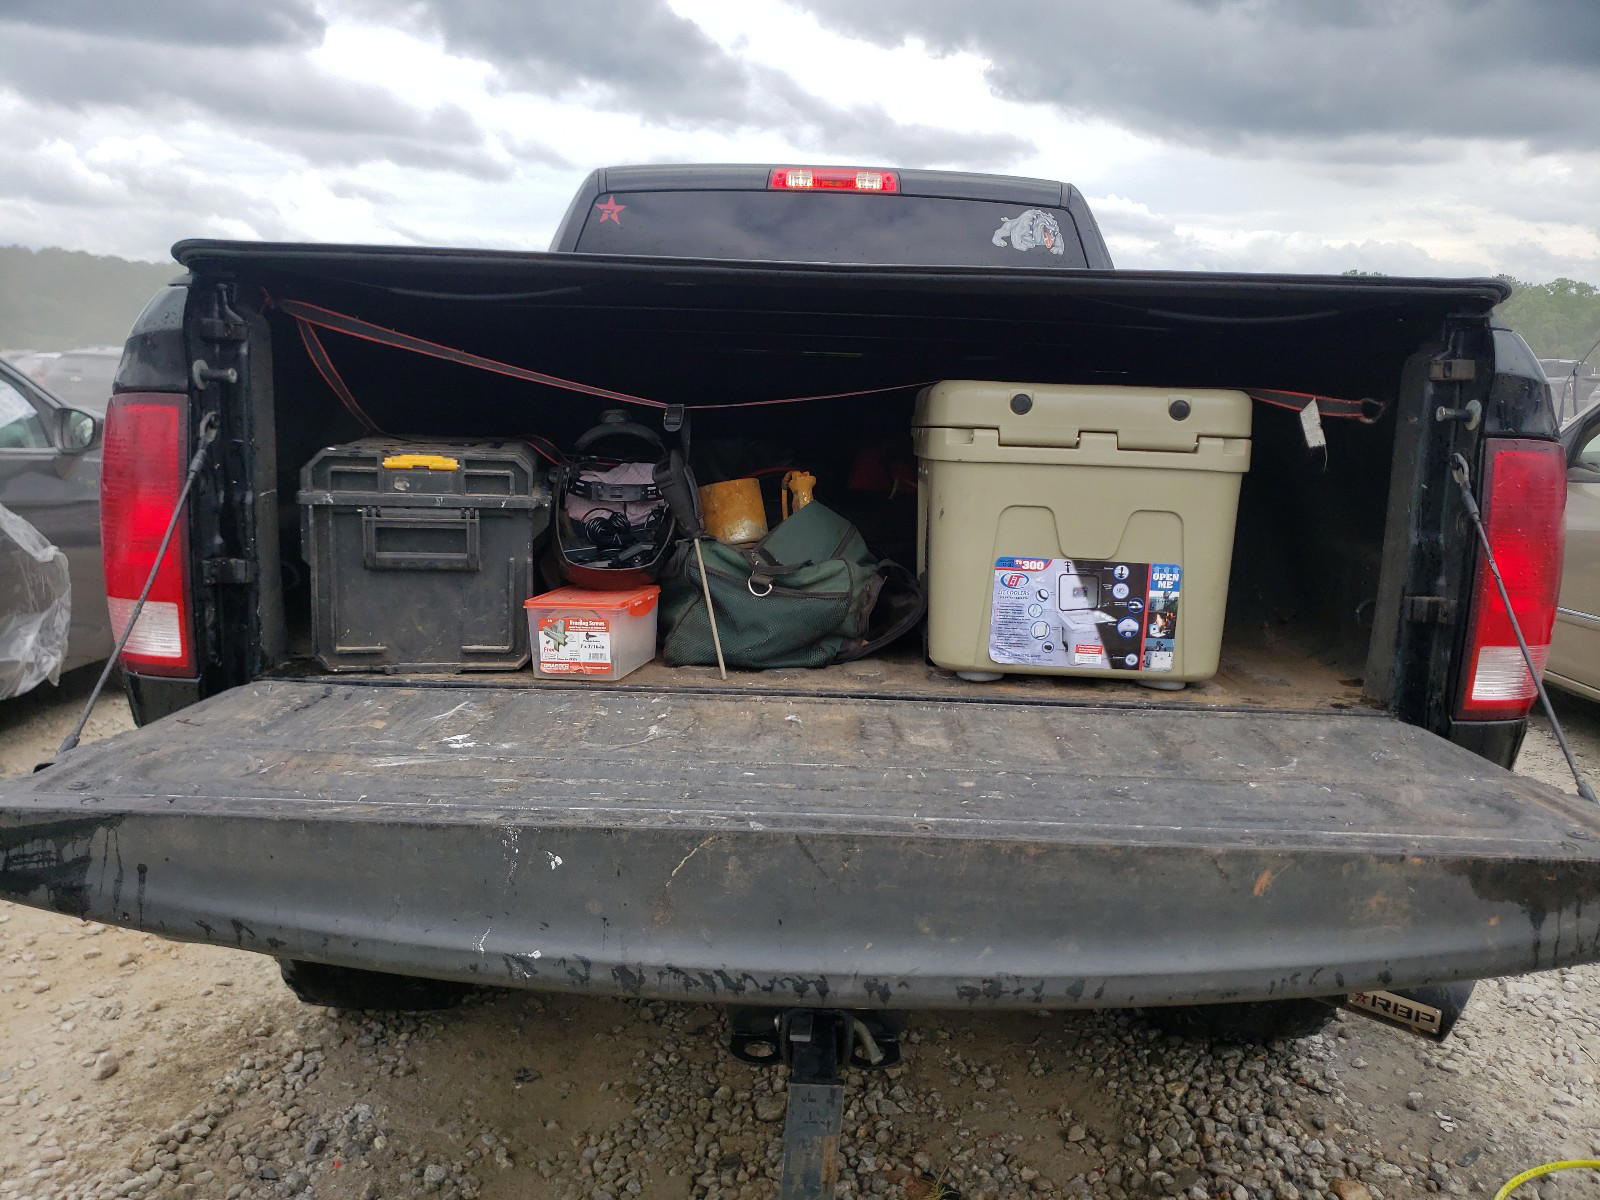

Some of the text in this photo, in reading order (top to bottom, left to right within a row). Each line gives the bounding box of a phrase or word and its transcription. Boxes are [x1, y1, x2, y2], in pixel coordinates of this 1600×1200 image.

[1022, 560, 1044, 570] 300
[1152, 573, 1179, 581] OPEN
[1157, 580, 1174, 589] ME
[1372, 995, 1435, 1022] RBP
